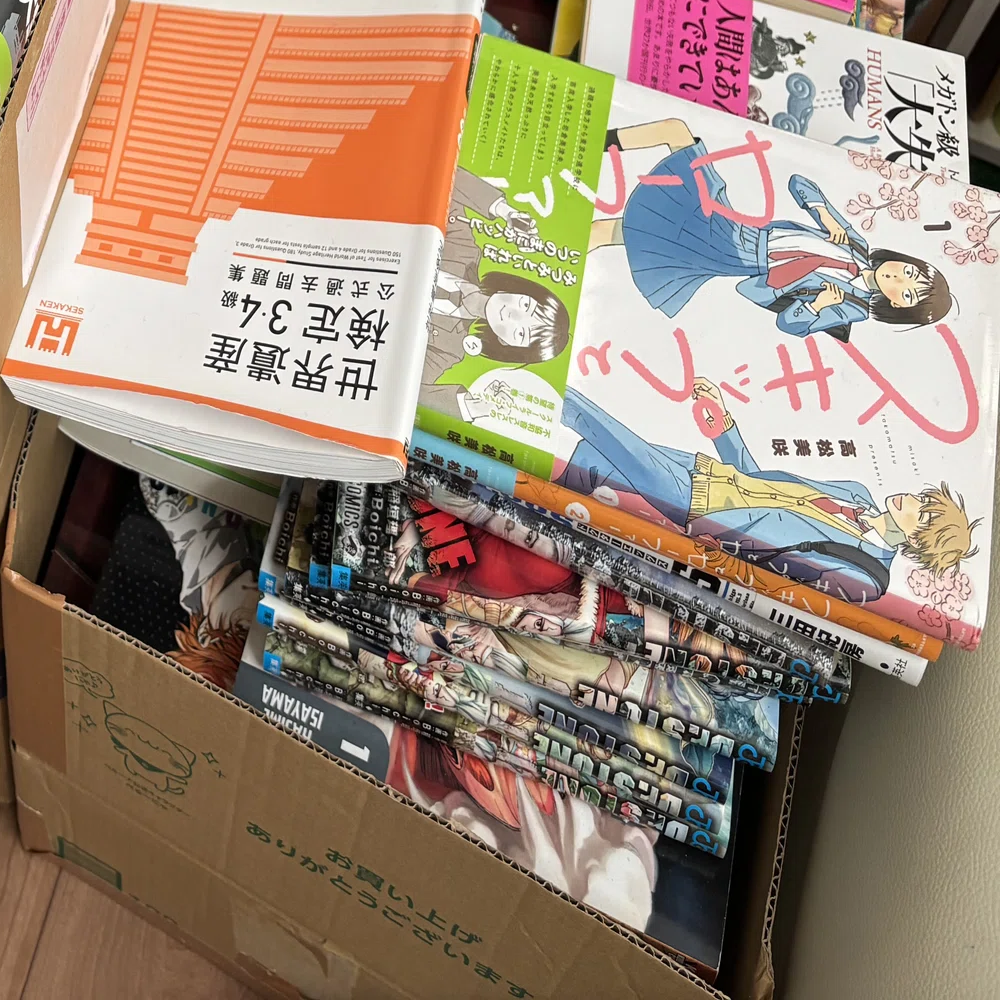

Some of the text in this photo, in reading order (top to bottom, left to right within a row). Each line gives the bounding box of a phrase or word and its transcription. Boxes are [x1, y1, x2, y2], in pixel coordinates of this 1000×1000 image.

[866, 48, 882, 131] HUMANS
[932, 66, 961, 158] メガトン級
[923, 219, 951, 232] 1
[262, 244, 286, 253] Questions
[302, 242, 320, 250] sample
[312, 249, 333, 259] Heritage
[342, 246, 357, 254] Grade
[366, 247, 391, 256] Questions
[374, 255, 400, 266] Exercises
[225, 262, 396, 300] 公式過去問題集
[38, 297, 85, 316] SEKAKEN
[301, 302, 391, 352] 検定
[202, 330, 382, 401] 世界遺産
[576, 324, 981, 445] スキップと
[446, 429, 515, 464] 高松美咲
[771, 438, 858, 458] 高松美咲
[366, 496, 385, 565] Boichi
[766, 605, 867, 663] 三田紀房
[261, 683, 325, 730] ISAYAMA
[337, 736, 372, 762] 1
[246, 820, 534, 1000] ありがとうございます
[326, 844, 483, 947] お買い上げ
